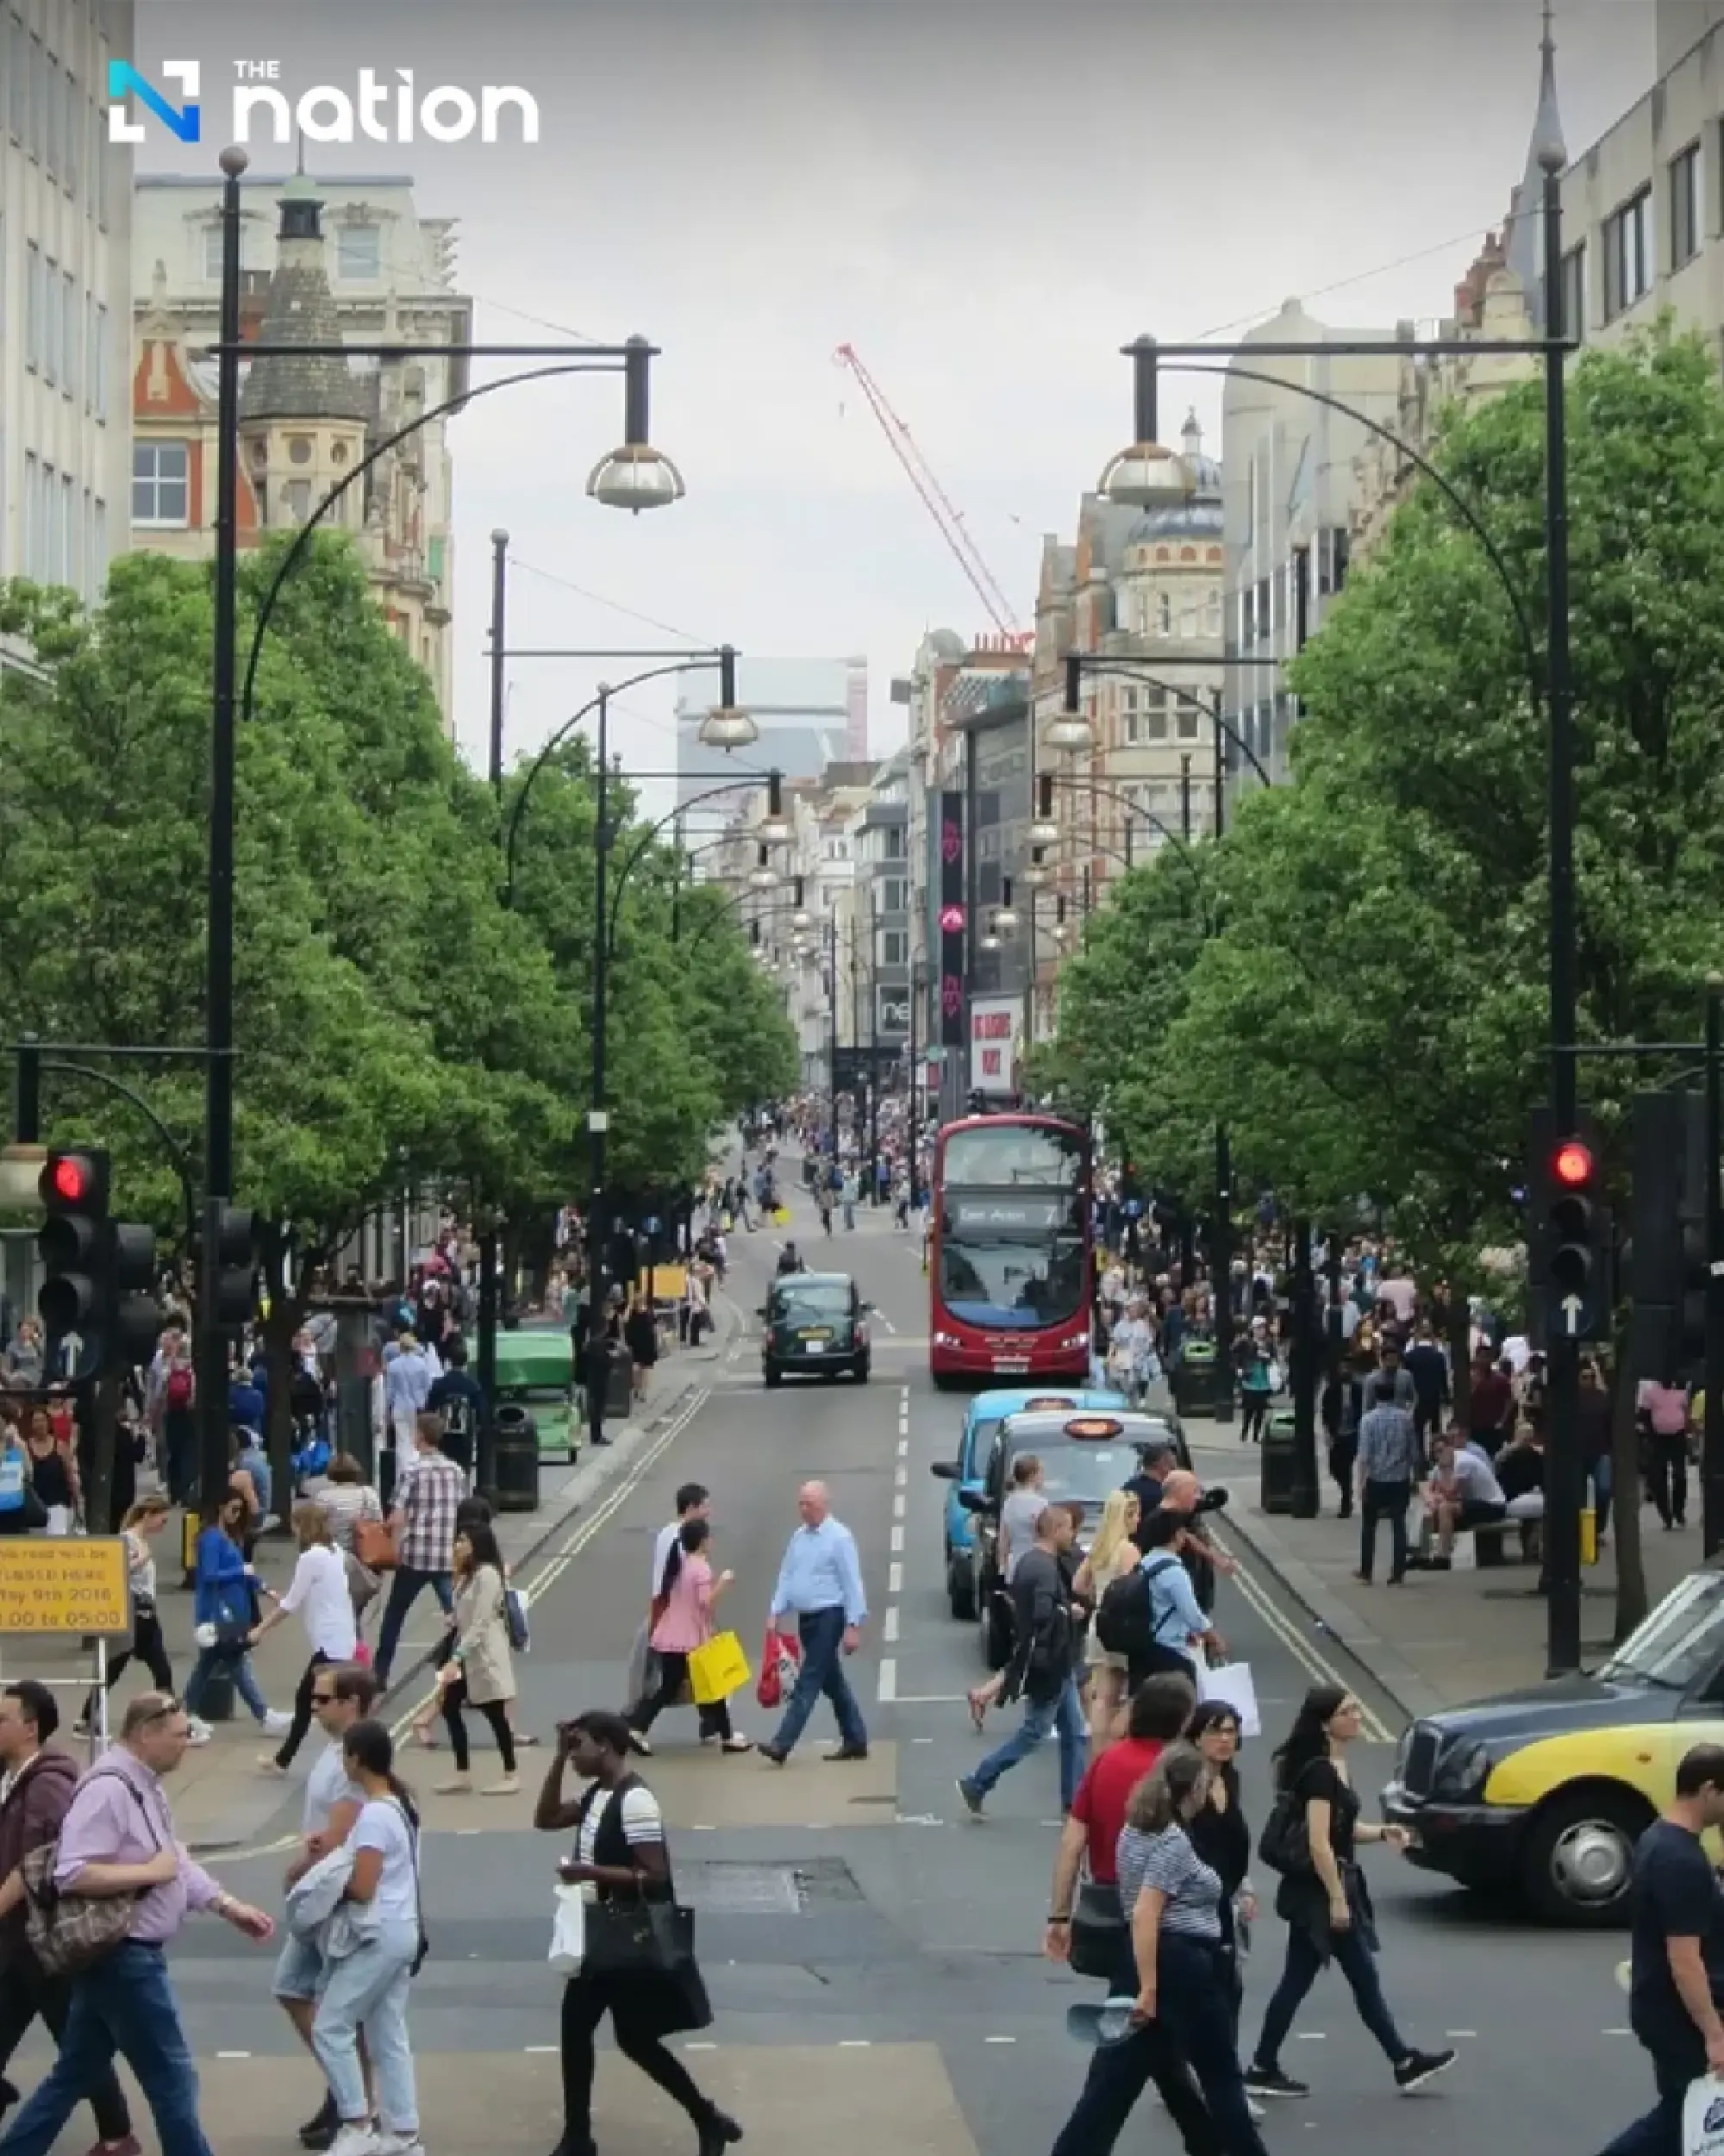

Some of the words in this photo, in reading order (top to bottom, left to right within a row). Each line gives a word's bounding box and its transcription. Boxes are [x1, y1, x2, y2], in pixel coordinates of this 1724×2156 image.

[1045, 1205, 1058, 1224] 7
[0, 1570, 58, 1581] LOSED
[41, 1611, 58, 1626] to
